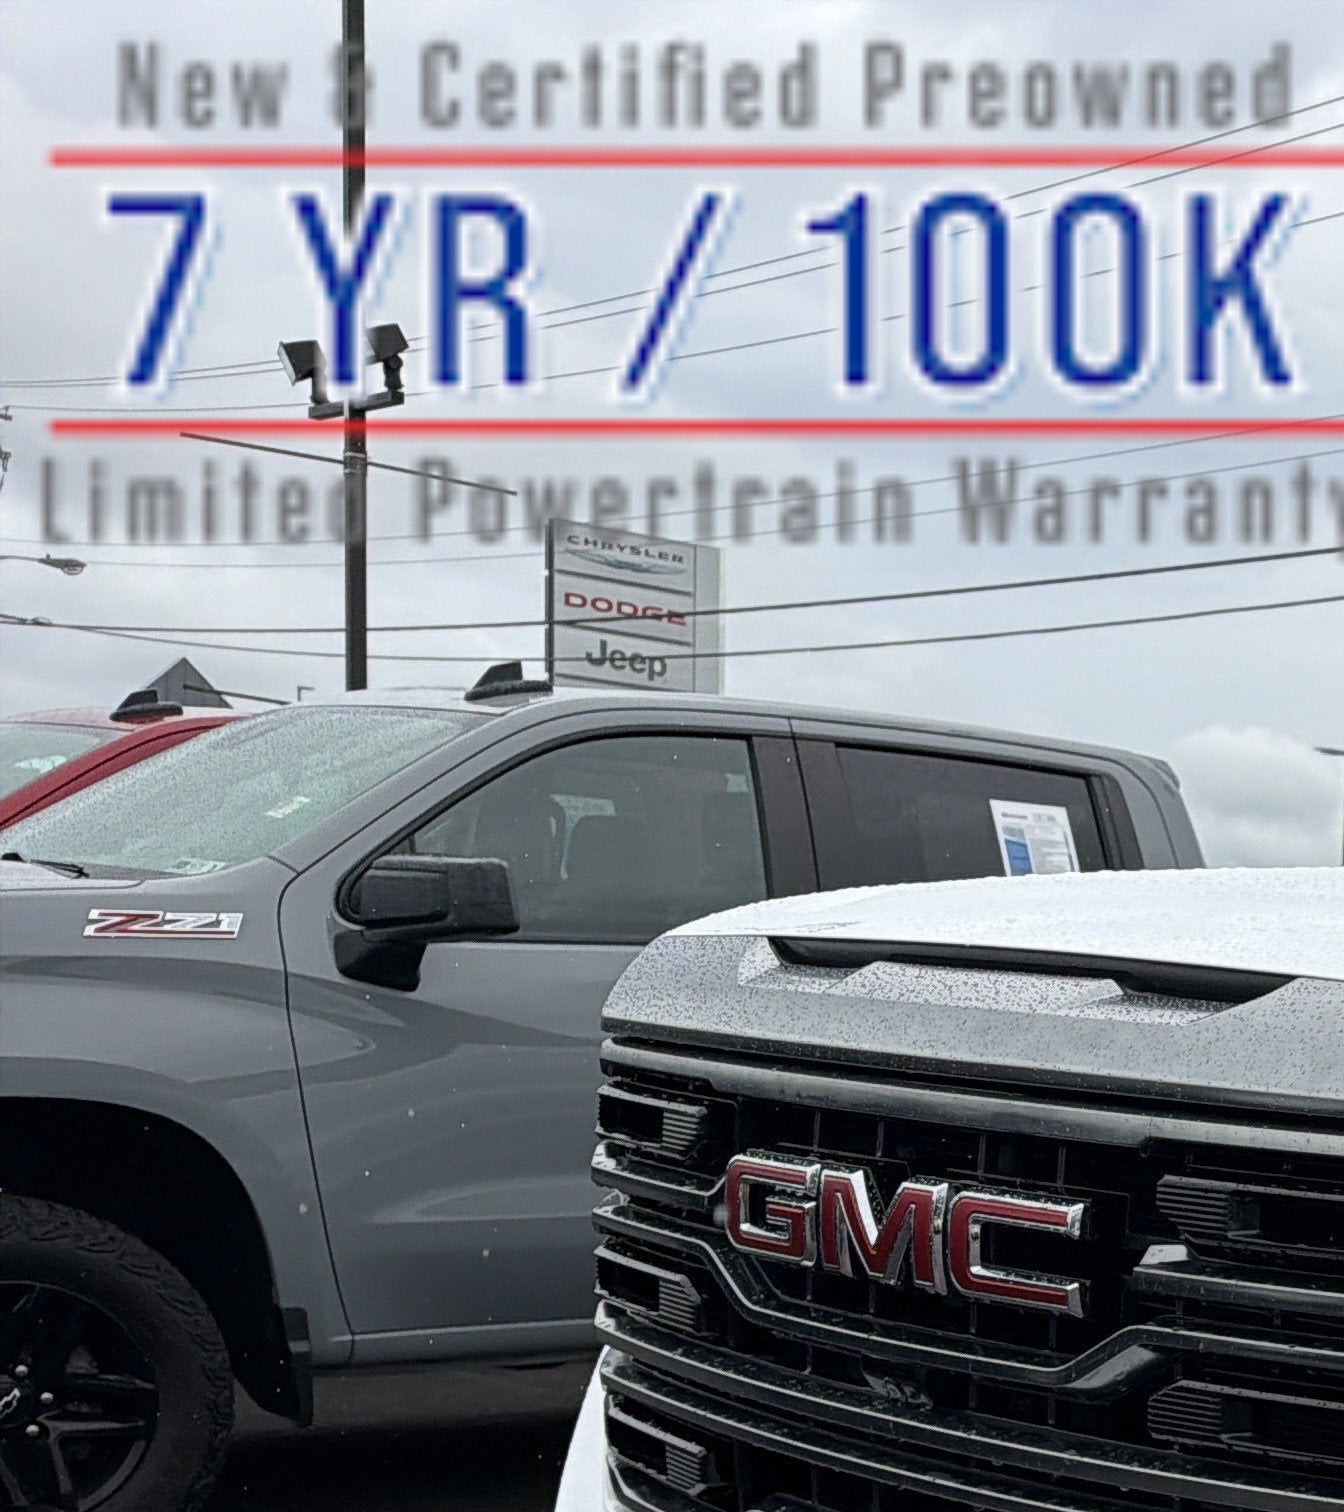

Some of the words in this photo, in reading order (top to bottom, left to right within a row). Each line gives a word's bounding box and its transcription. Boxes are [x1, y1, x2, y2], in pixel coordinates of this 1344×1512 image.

[566, 534, 685, 564] CHRYSLER
[563, 591, 687, 627] DODGE
[585, 639, 667, 681] Jeep
[82, 907, 244, 939] Z71
[725, 1152, 1090, 1319] GMC
